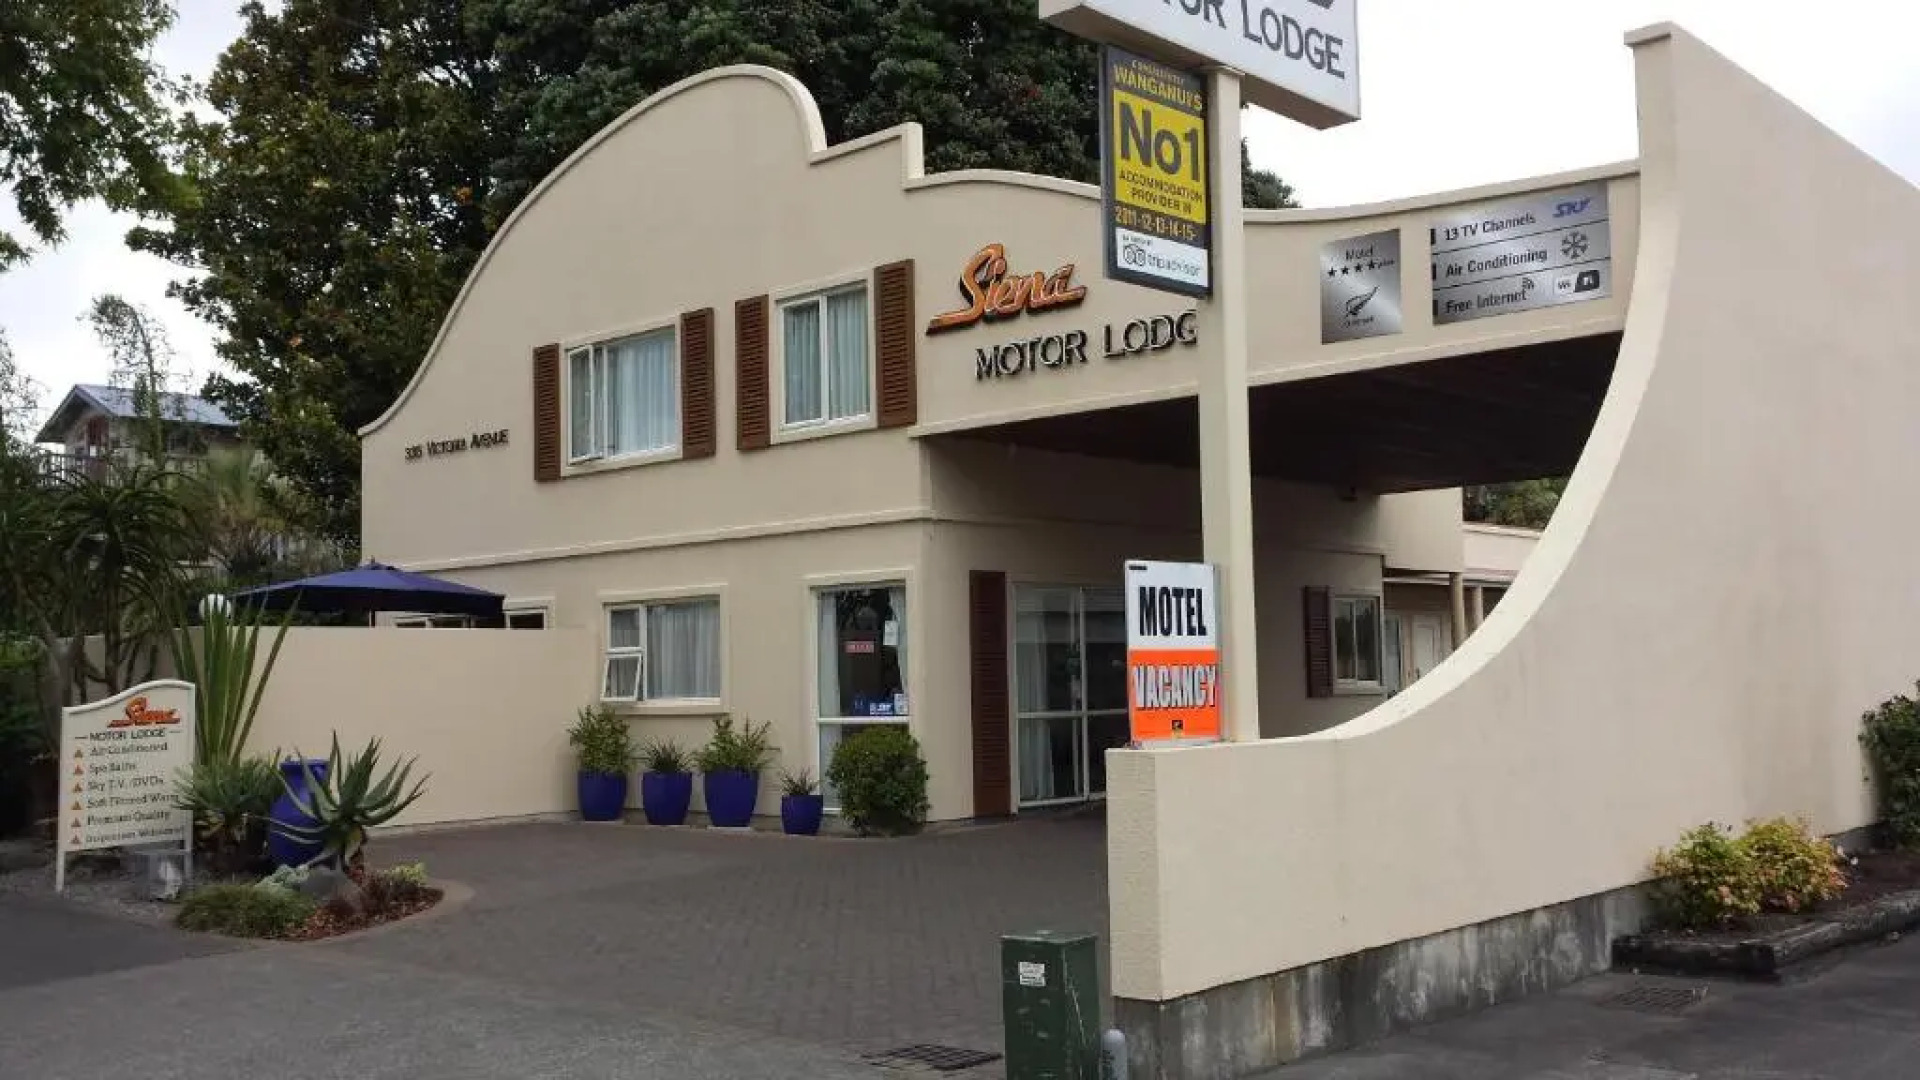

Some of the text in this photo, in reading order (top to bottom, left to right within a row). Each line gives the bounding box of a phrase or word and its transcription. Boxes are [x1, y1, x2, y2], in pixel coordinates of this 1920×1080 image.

[1241, 0, 1345, 79] LODGE
[1130, 187, 1180, 210] PROVIDER
[1444, 213, 1537, 241] 13 TV Channels
[1446, 249, 1548, 277] Air Conditioning
[1446, 290, 1527, 314] Free Internet
[975, 309, 1199, 381] MOTOR LODG
[1139, 586, 1208, 636] MOTEL
[1134, 665, 1216, 709] VACANCY
[89, 728, 165, 742] MOTOR LODGE
